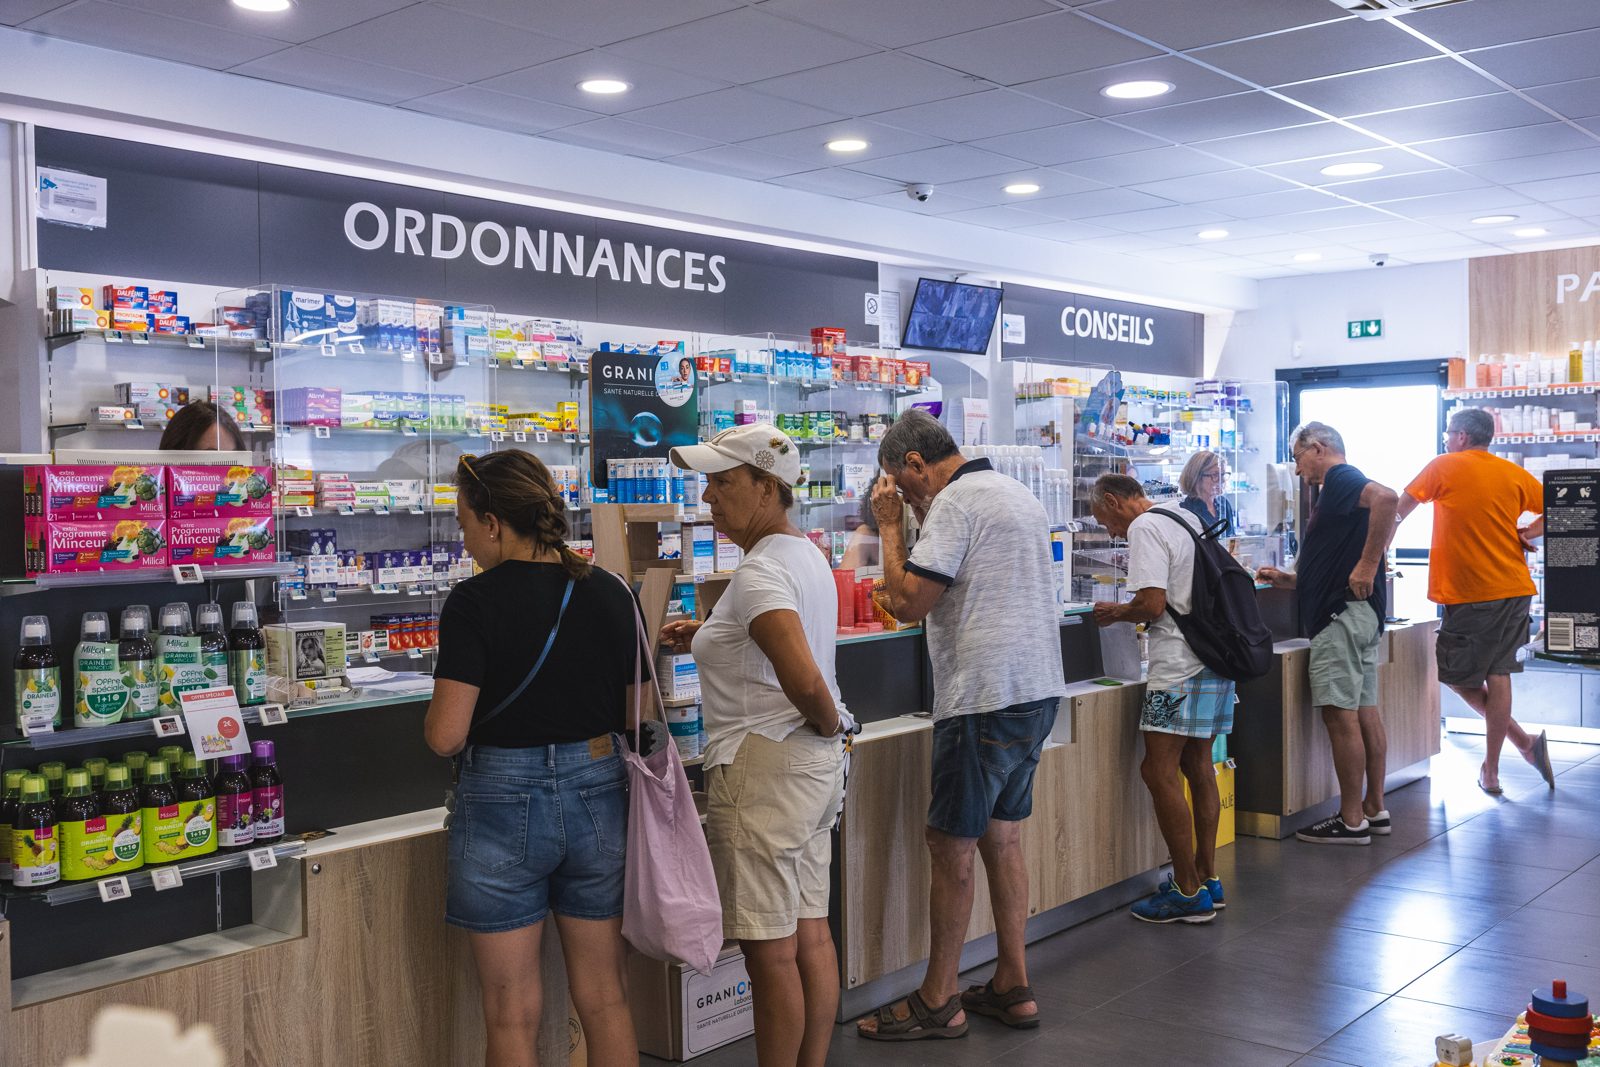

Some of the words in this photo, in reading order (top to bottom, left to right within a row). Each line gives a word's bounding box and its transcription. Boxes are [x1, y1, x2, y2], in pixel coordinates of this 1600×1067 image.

[343, 201, 727, 294] ORDONNANCES
[295, 297, 321, 305] marimer
[1060, 306, 1155, 346] CONSEILS
[602, 365, 653, 381] GRANI
[603, 387, 622, 396] SANTÉ
[623, 389, 654, 397] NATURELLE
[48, 473, 105, 484] Programme
[173, 474, 220, 484] Programme
[48, 482, 104, 493] Minceur
[173, 483, 221, 492] Minceur
[140, 503, 163, 511] Milical
[250, 501, 271, 509] Milical
[48, 513, 58, 521] 21
[173, 510, 181, 518] 21
[52, 530, 107, 540] Programme
[171, 527, 221, 537] Programme
[52, 538, 107, 549] Minceur
[171, 535, 220, 545] Minceur
[252, 552, 273, 560] Milical
[142, 557, 165, 565] Milical
[166, 639, 190, 648] Milical
[81, 645, 106, 654] Milical
[180, 670, 203, 678] Offre
[95, 678, 121, 686] Offre
[177, 676, 207, 685] spéciale
[91, 684, 125, 694] spéciale
[26, 692, 57, 700] DRAINEUR
[160, 811, 178, 819] Milical
[86, 825, 105, 833] Milical
[154, 822, 184, 831] DRAINEUR
[31, 869, 57, 878] DRAINEUR
[711, 1012, 737, 1025] NATURELLE
